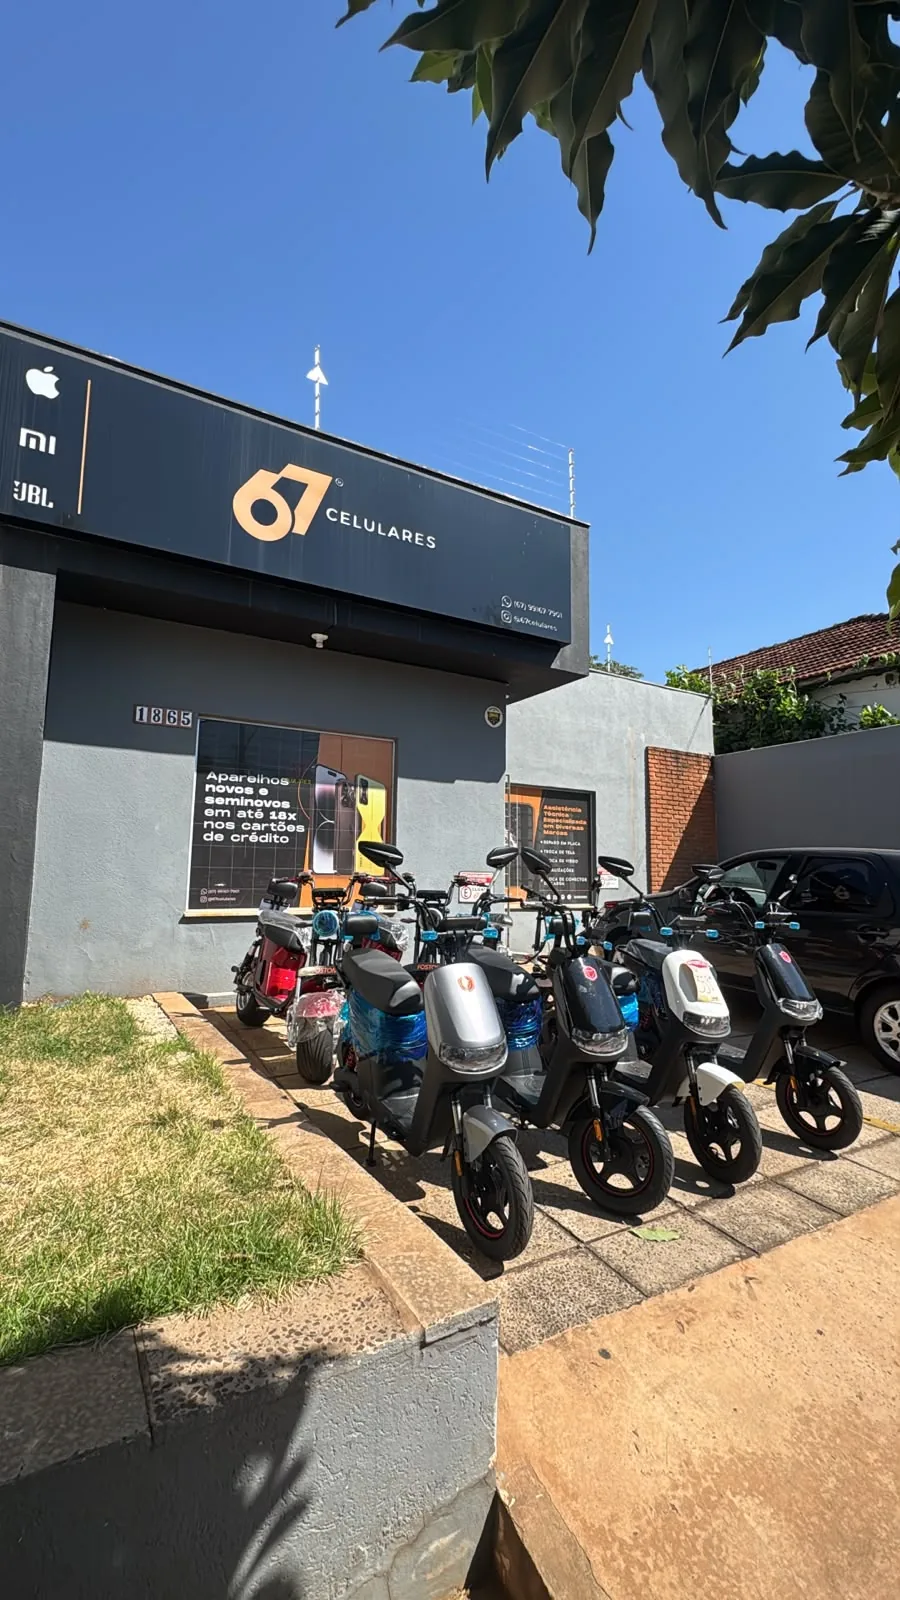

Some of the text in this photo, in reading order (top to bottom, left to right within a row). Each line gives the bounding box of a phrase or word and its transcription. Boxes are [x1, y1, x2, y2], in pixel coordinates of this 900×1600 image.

[13, 480, 54, 509] JBL
[232, 463, 333, 542] 67
[325, 507, 436, 549] CELULARES
[138, 707, 191, 726] 1865
[206, 771, 290, 786] Aparelhos
[205, 784, 269, 796] novos e
[204, 796, 291, 809] seminovos
[204, 808, 297, 821] em até 18x
[203, 821, 305, 833] nos cartões
[203, 831, 290, 844] de crédito
